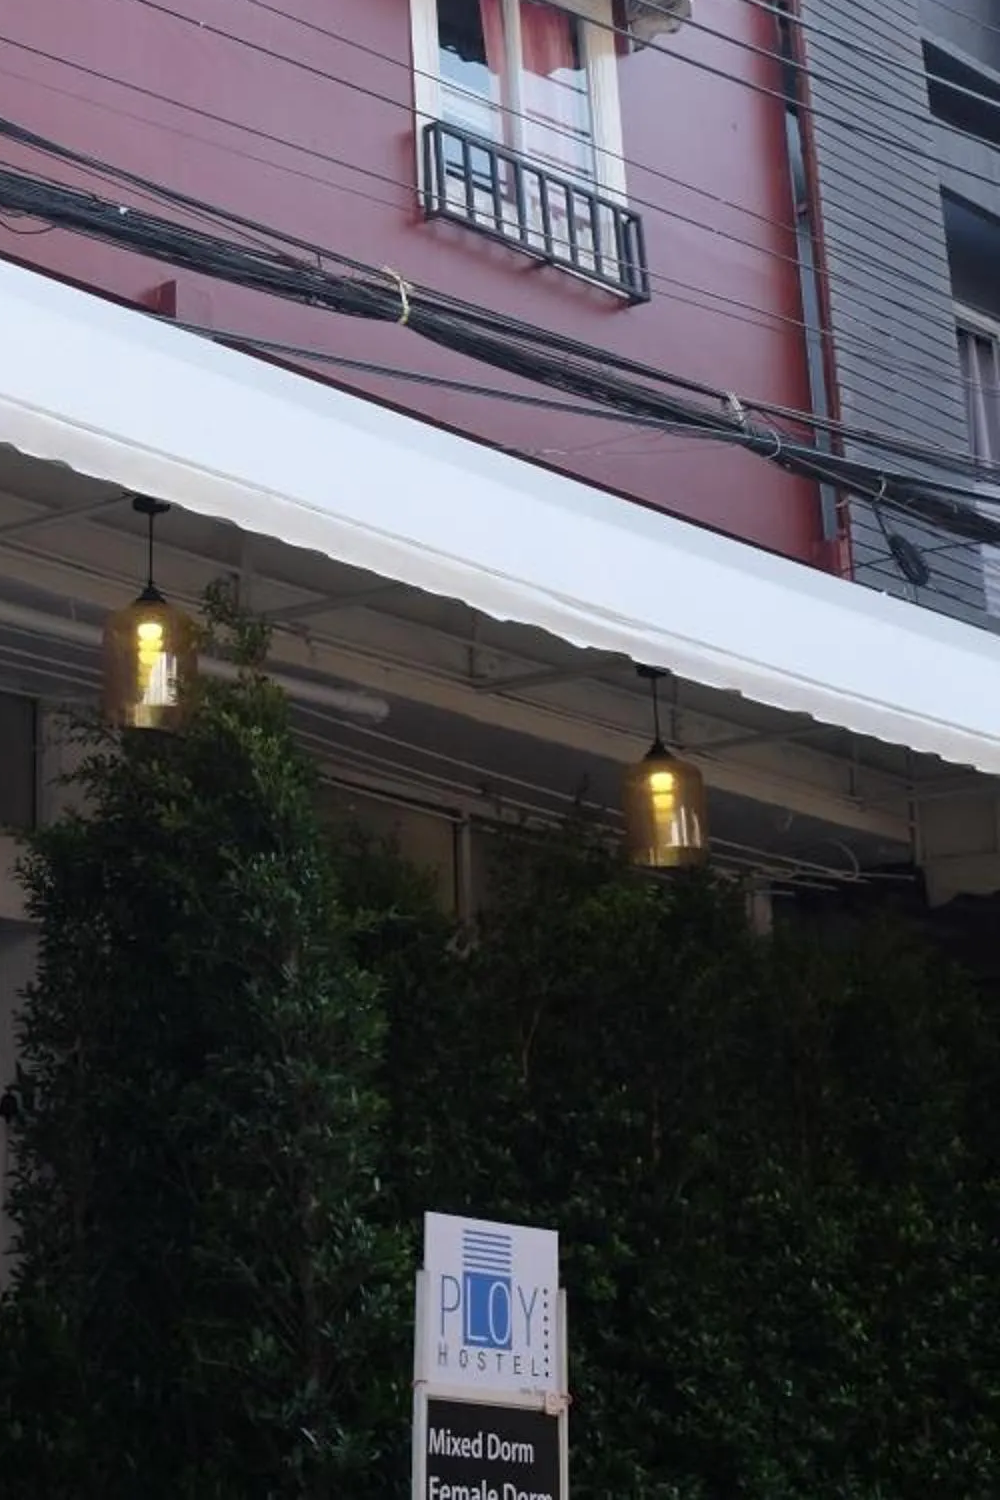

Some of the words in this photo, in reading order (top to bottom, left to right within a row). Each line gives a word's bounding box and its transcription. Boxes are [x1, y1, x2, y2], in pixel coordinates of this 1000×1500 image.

[440, 1273, 539, 1347] PLOY
[437, 1341, 540, 1378] HOSTEL
[428, 1427, 483, 1459] Mixed
[487, 1432, 535, 1464] Dorm
[428, 1475, 499, 1500] Female
